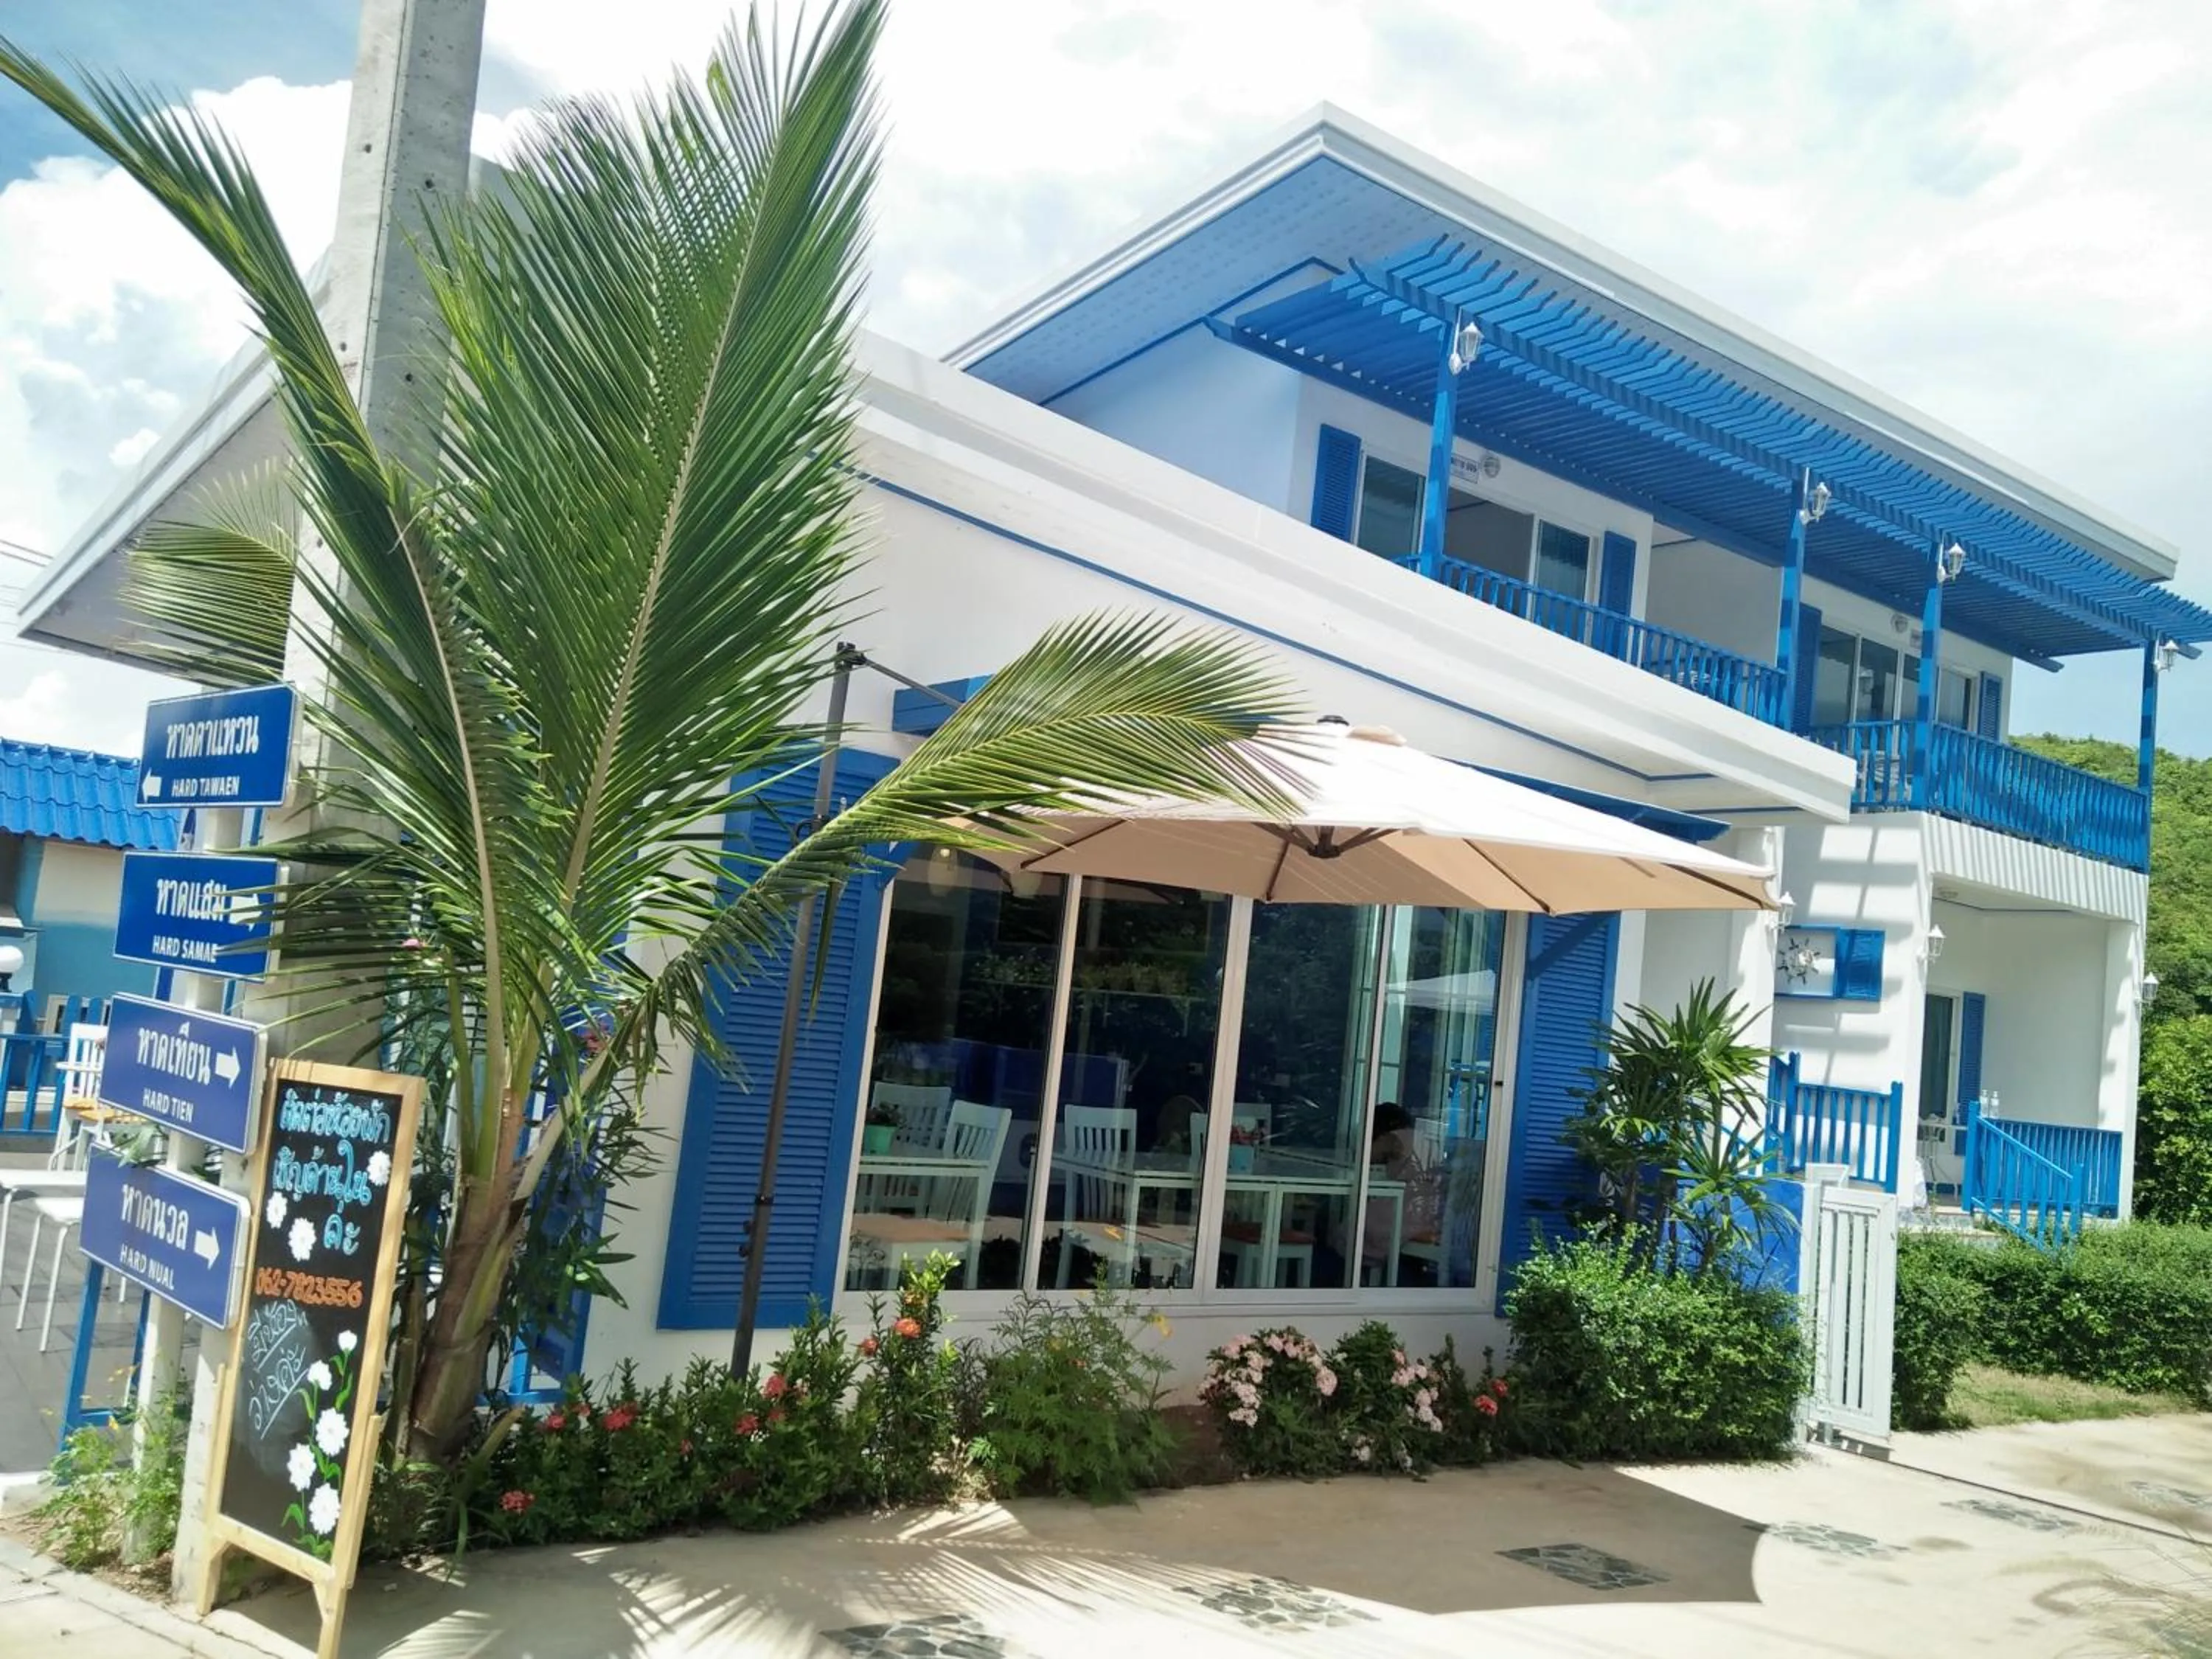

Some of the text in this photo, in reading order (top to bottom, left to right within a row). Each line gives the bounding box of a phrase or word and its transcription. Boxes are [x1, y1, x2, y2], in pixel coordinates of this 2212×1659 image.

[167, 715, 260, 760] หาดตาแหวน
[172, 776, 240, 797] HARD TAWAEN
[152, 935, 218, 963] HARD SAMAE
[138, 1021, 212, 1086] หาดเทียน
[143, 1088, 194, 1122] HARD TIEN
[122, 1183, 189, 1251] หาดนวล
[120, 1244, 175, 1290] HARD NUAL
